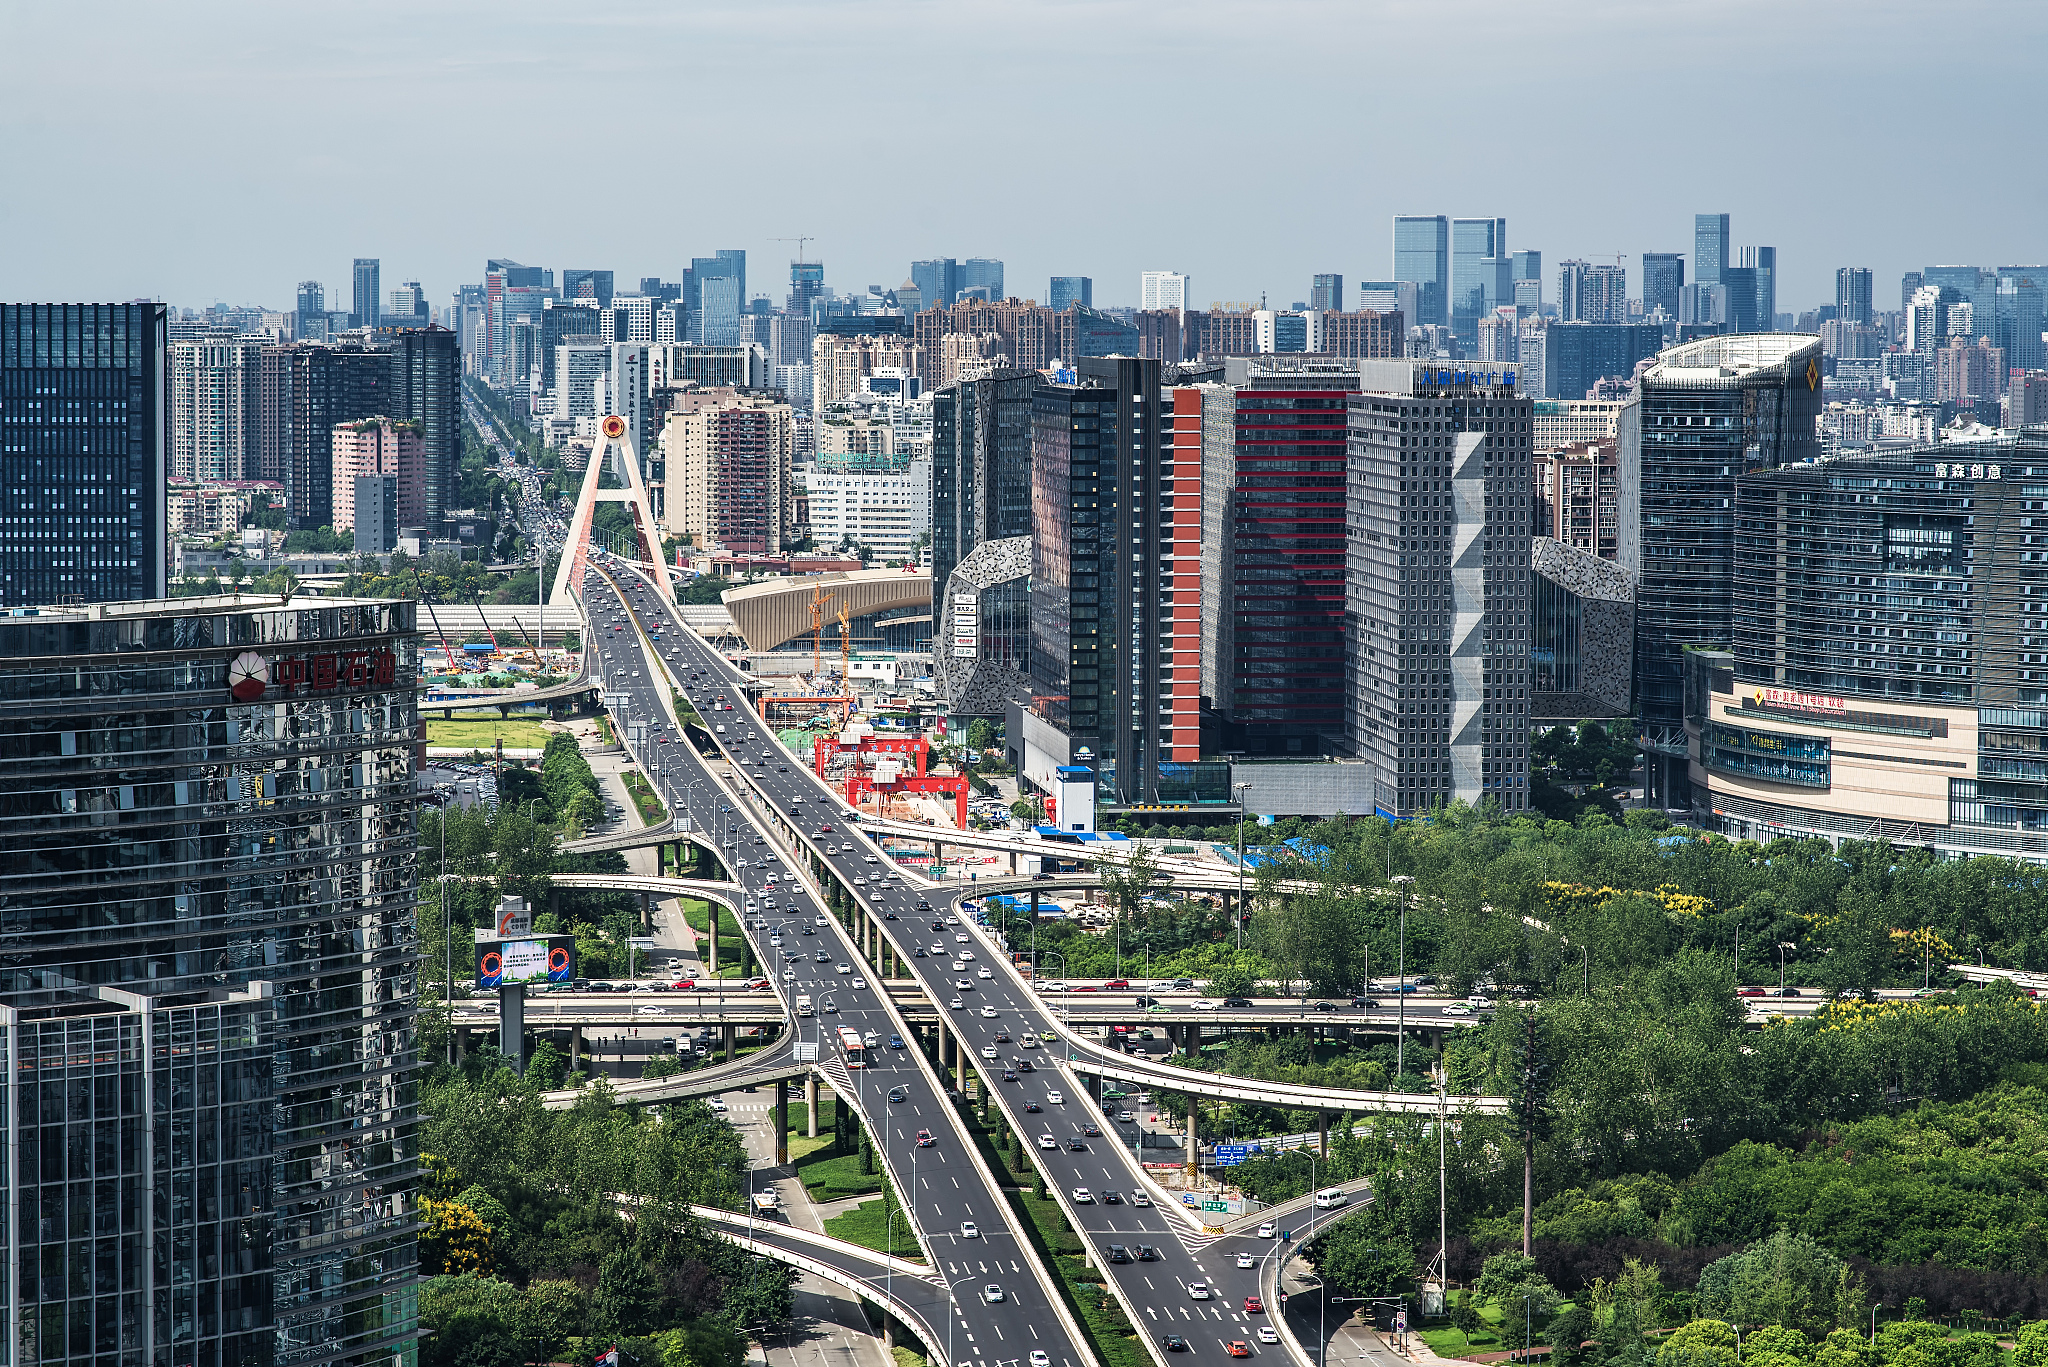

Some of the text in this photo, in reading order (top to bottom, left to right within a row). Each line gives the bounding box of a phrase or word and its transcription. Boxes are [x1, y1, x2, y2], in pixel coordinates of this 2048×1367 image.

[1421, 370, 1516, 385] 大鼎世纪广场
[1935, 463, 2002, 479] 富森创意
[902, 562, 918, 573] 成
[279, 648, 396, 692] 中国石油
